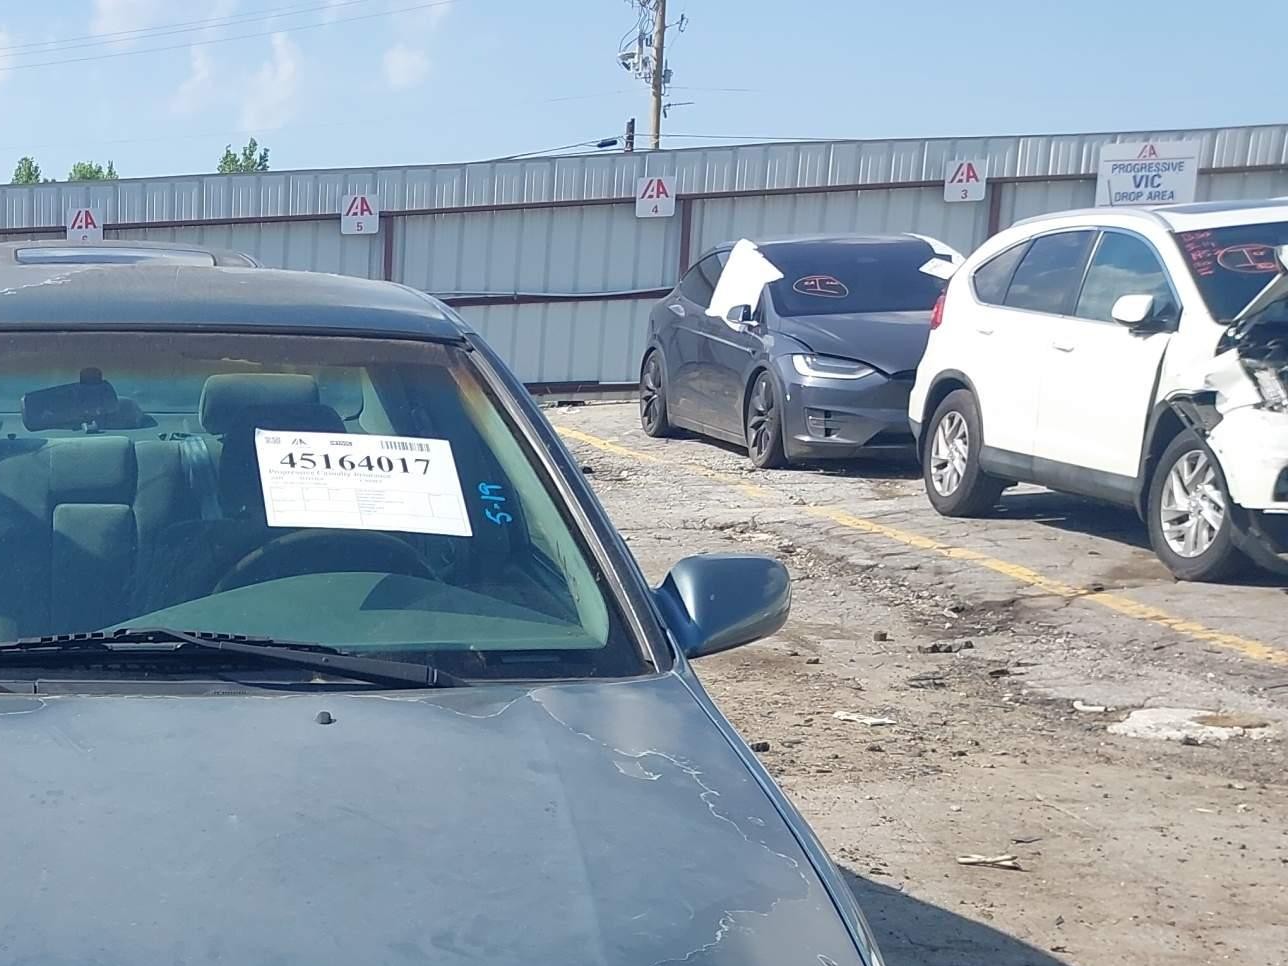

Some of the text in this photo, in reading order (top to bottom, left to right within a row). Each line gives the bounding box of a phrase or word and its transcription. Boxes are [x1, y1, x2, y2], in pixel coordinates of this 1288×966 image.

[1112, 161, 1185, 174] PROGRESSIVE
[1132, 174, 1162, 189] VIC
[960, 188, 969, 199] 3
[1114, 190, 1174, 202] DROP AREA
[650, 204, 659, 214] 4
[356, 221, 364, 231] 5
[279, 451, 431, 476] 45164017
